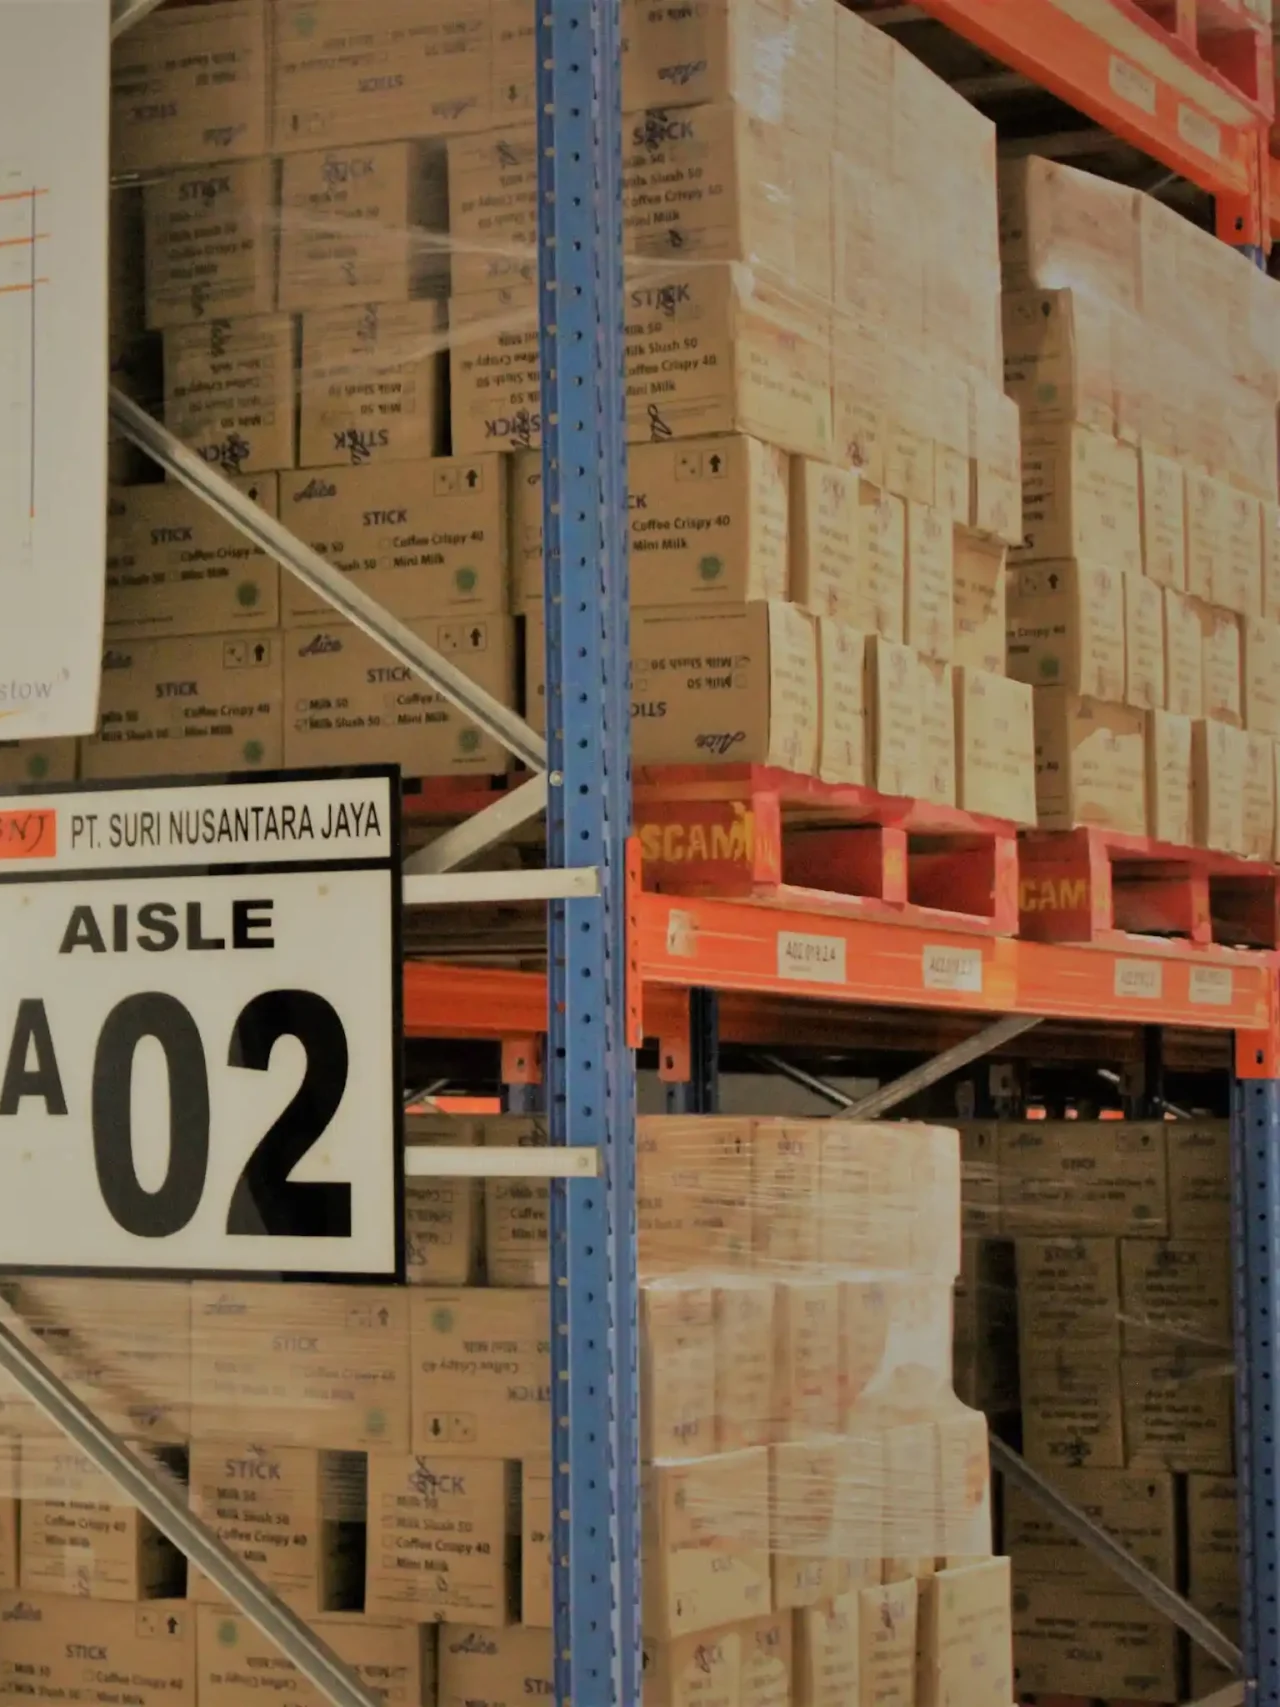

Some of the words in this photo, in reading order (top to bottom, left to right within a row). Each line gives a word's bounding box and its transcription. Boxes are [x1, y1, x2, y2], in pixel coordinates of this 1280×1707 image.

[661, 357, 699, 372] Crispy
[702, 354, 717, 366] 40
[361, 508, 408, 527] STICK
[631, 519, 670, 533] Coffee
[674, 517, 710, 533] Crispy
[714, 515, 731, 528] 40
[150, 527, 193, 545] STICK
[392, 535, 431, 550] Coffee
[433, 532, 467, 548] Crispy
[469, 529, 484, 542] 40
[632, 540, 659, 552] Mini
[661, 538, 687, 551] Milk
[366, 666, 412, 684] STICK
[155, 681, 199, 698] STICK
[630, 701, 667, 718] STIC
[70, 813, 101, 849] PT.
[108, 811, 161, 848] SURI
[169, 804, 314, 846] NUSANTARA
[321, 800, 381, 840] JAYA
[1018, 879, 1087, 911] CAM
[59, 899, 275, 954] AISLE
[272, 1336, 319, 1353] STICK
[506, 1385, 551, 1402] TICK
[225, 1459, 281, 1481] STICK
[65, 1643, 108, 1661] STICK
